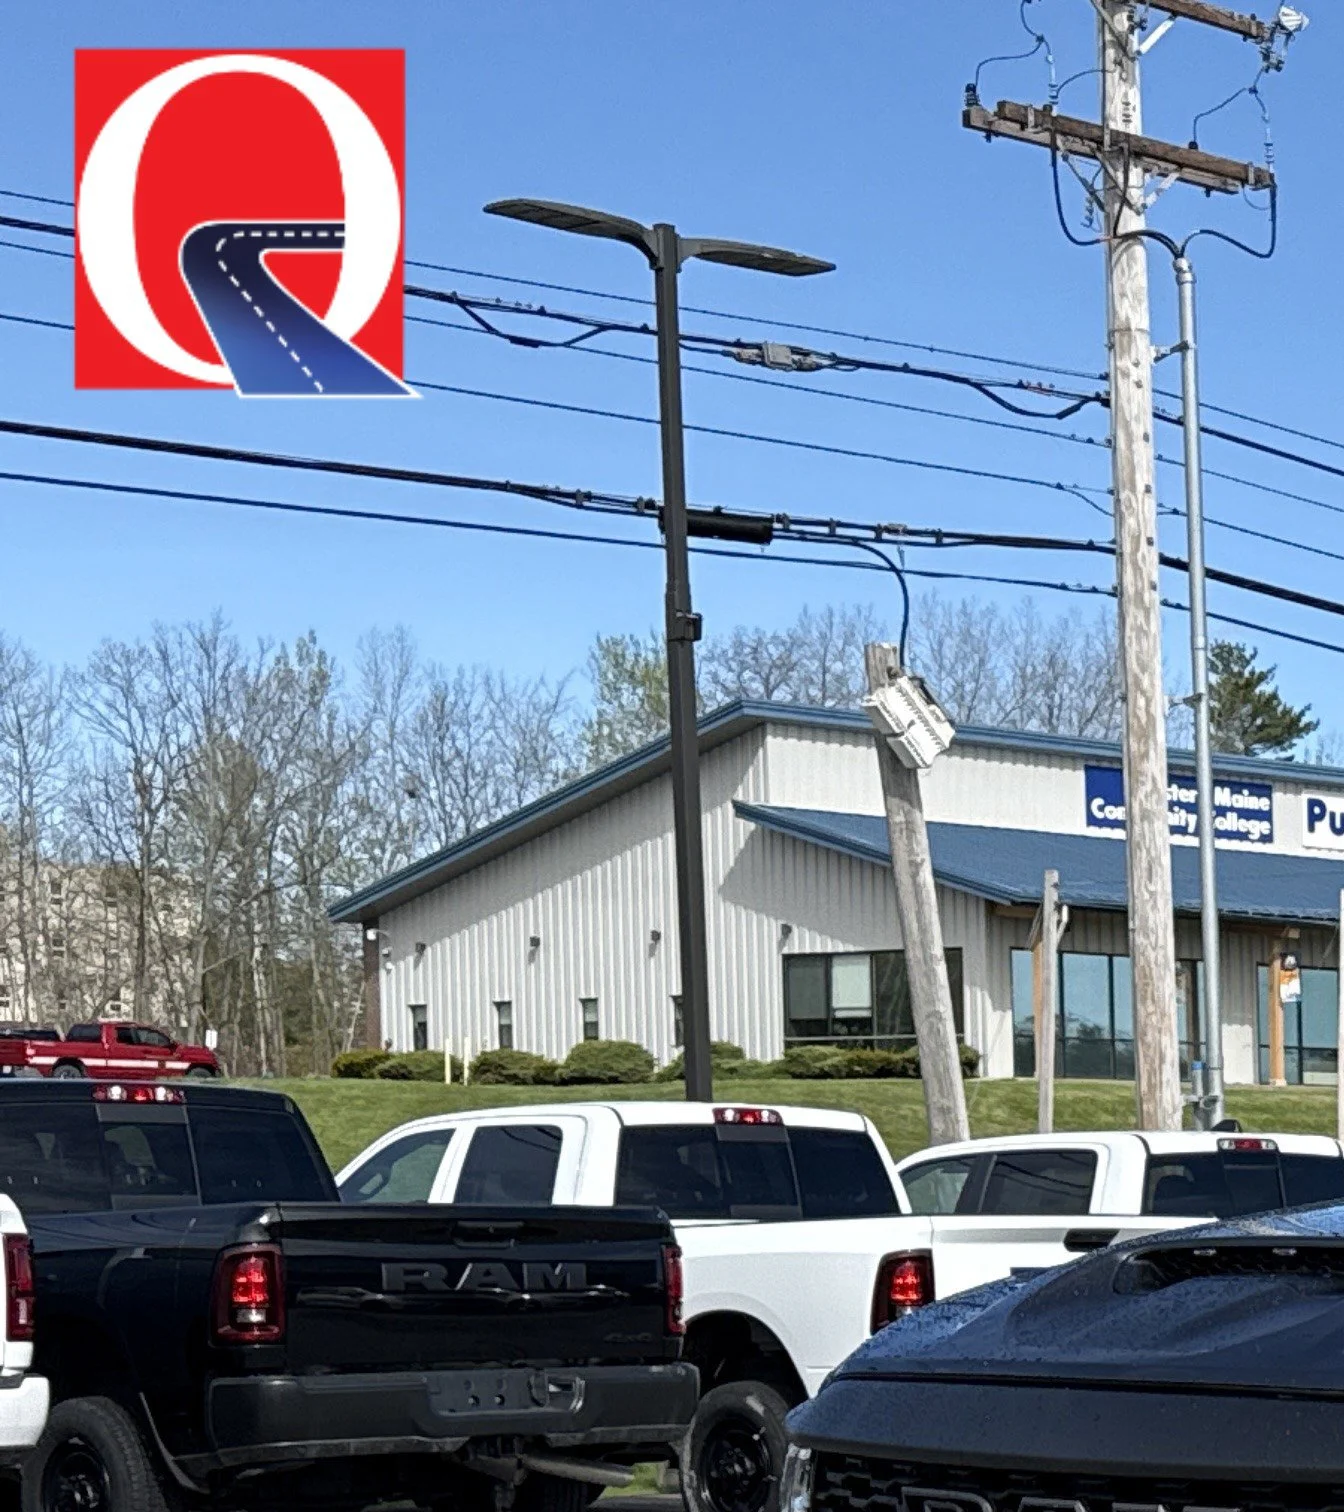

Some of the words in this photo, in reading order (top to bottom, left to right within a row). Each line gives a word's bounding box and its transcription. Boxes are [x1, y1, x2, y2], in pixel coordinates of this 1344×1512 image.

[1214, 785, 1271, 812] Maine
[1211, 809, 1272, 840] ollege
[381, 1262, 588, 1291] RAM
